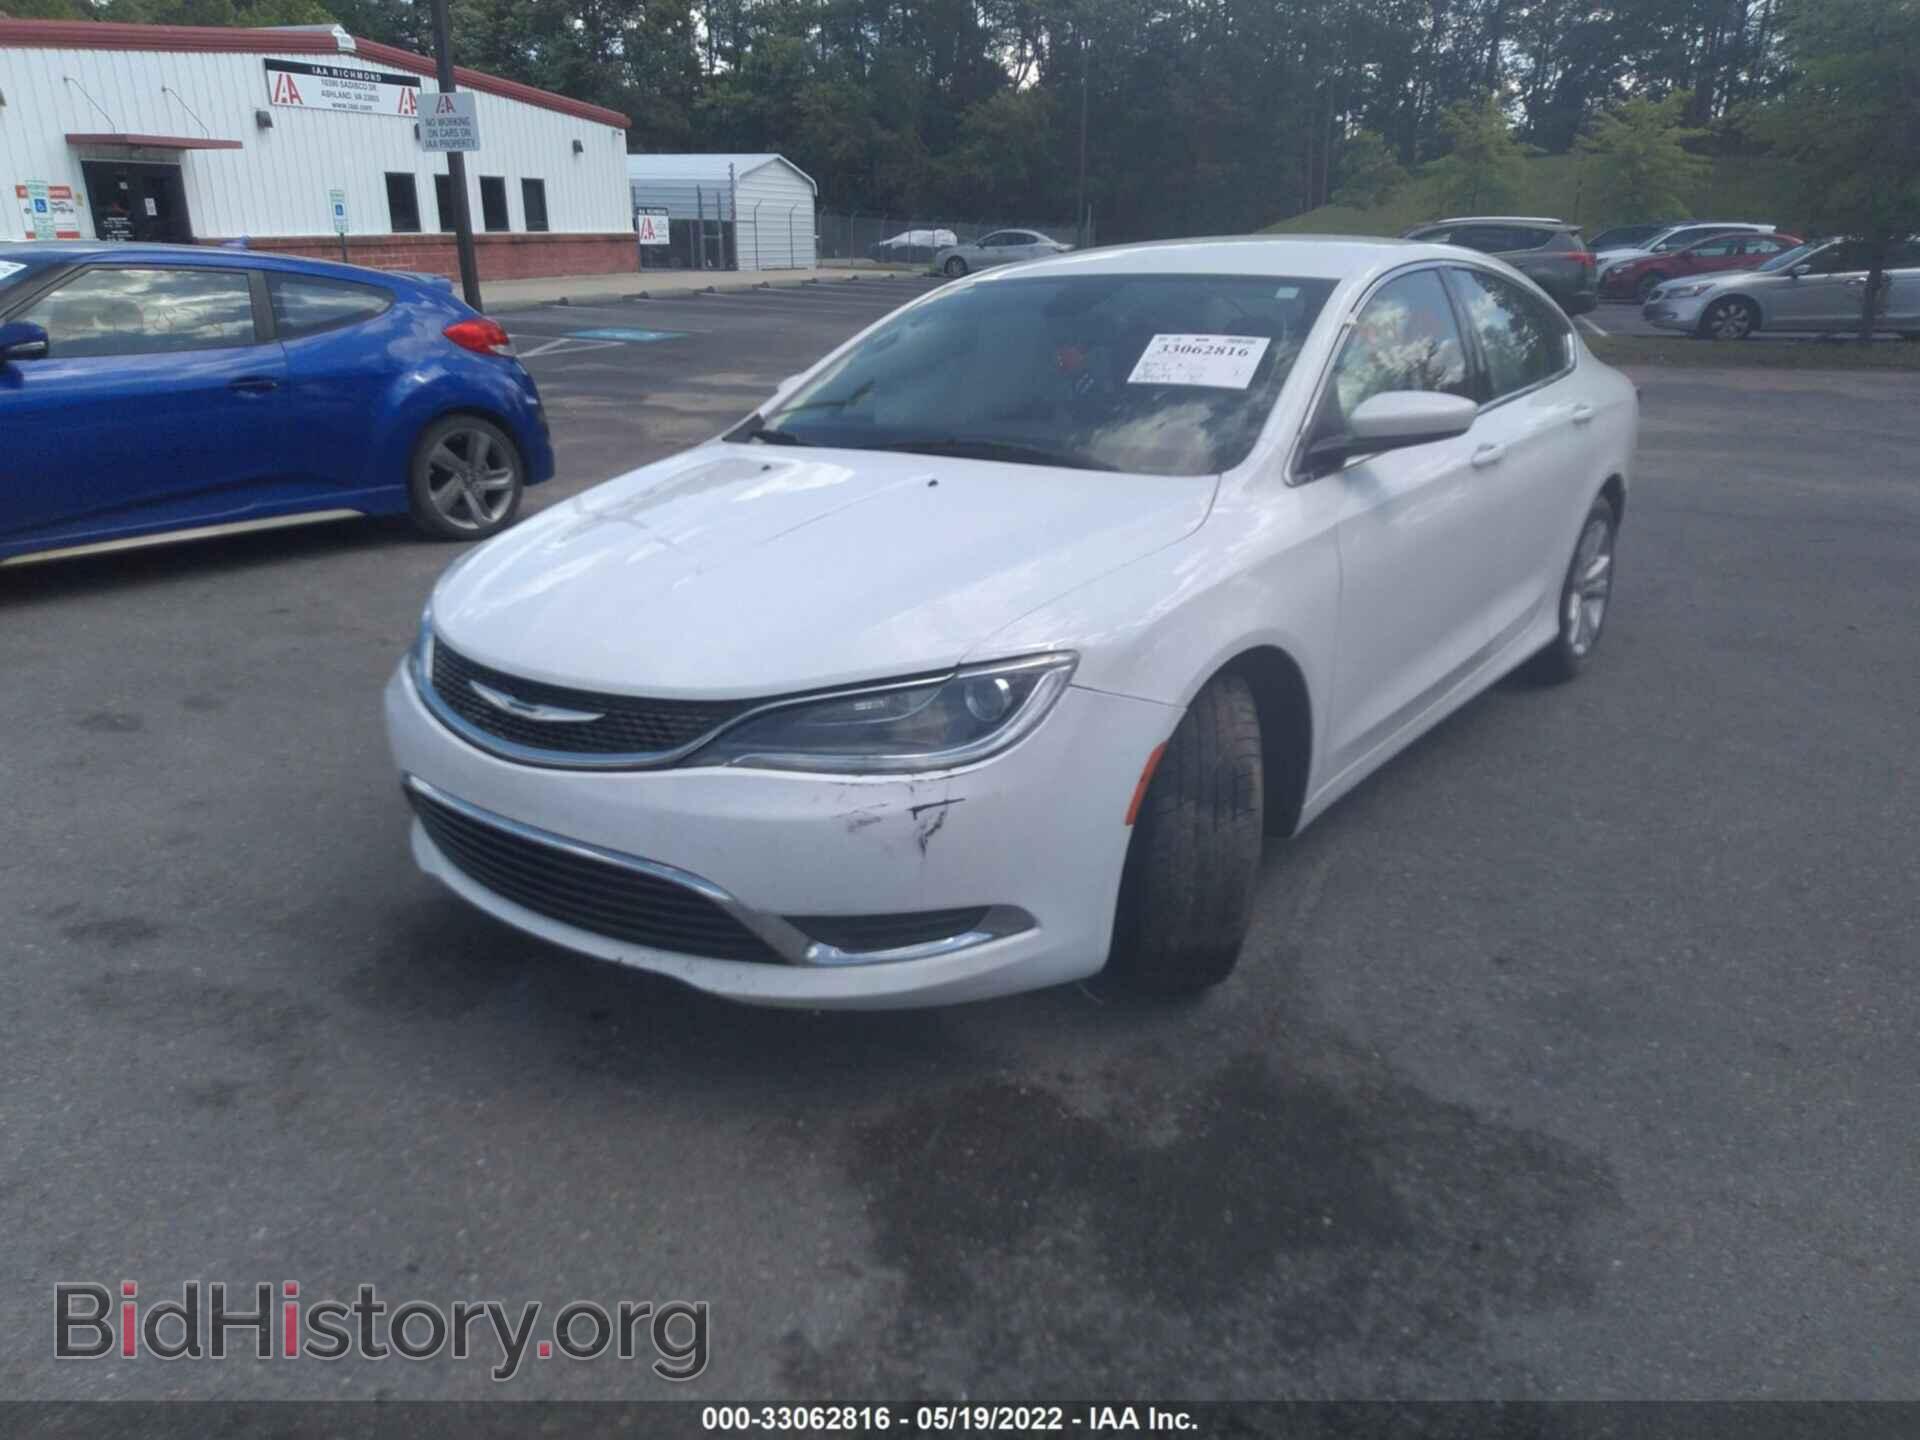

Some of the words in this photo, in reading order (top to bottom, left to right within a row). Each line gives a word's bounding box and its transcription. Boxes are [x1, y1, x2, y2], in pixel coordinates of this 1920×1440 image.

[312, 66, 329, 76] IAA
[333, 68, 382, 82] RICHMOND
[425, 117, 437, 128] NO
[438, 117, 471, 128] WORKING
[427, 127, 439, 138] ON
[440, 128, 459, 138] CARS
[460, 128, 472, 138] ON
[440, 138, 475, 149] PROPERTY
[1161, 343, 1249, 357] 33062816
